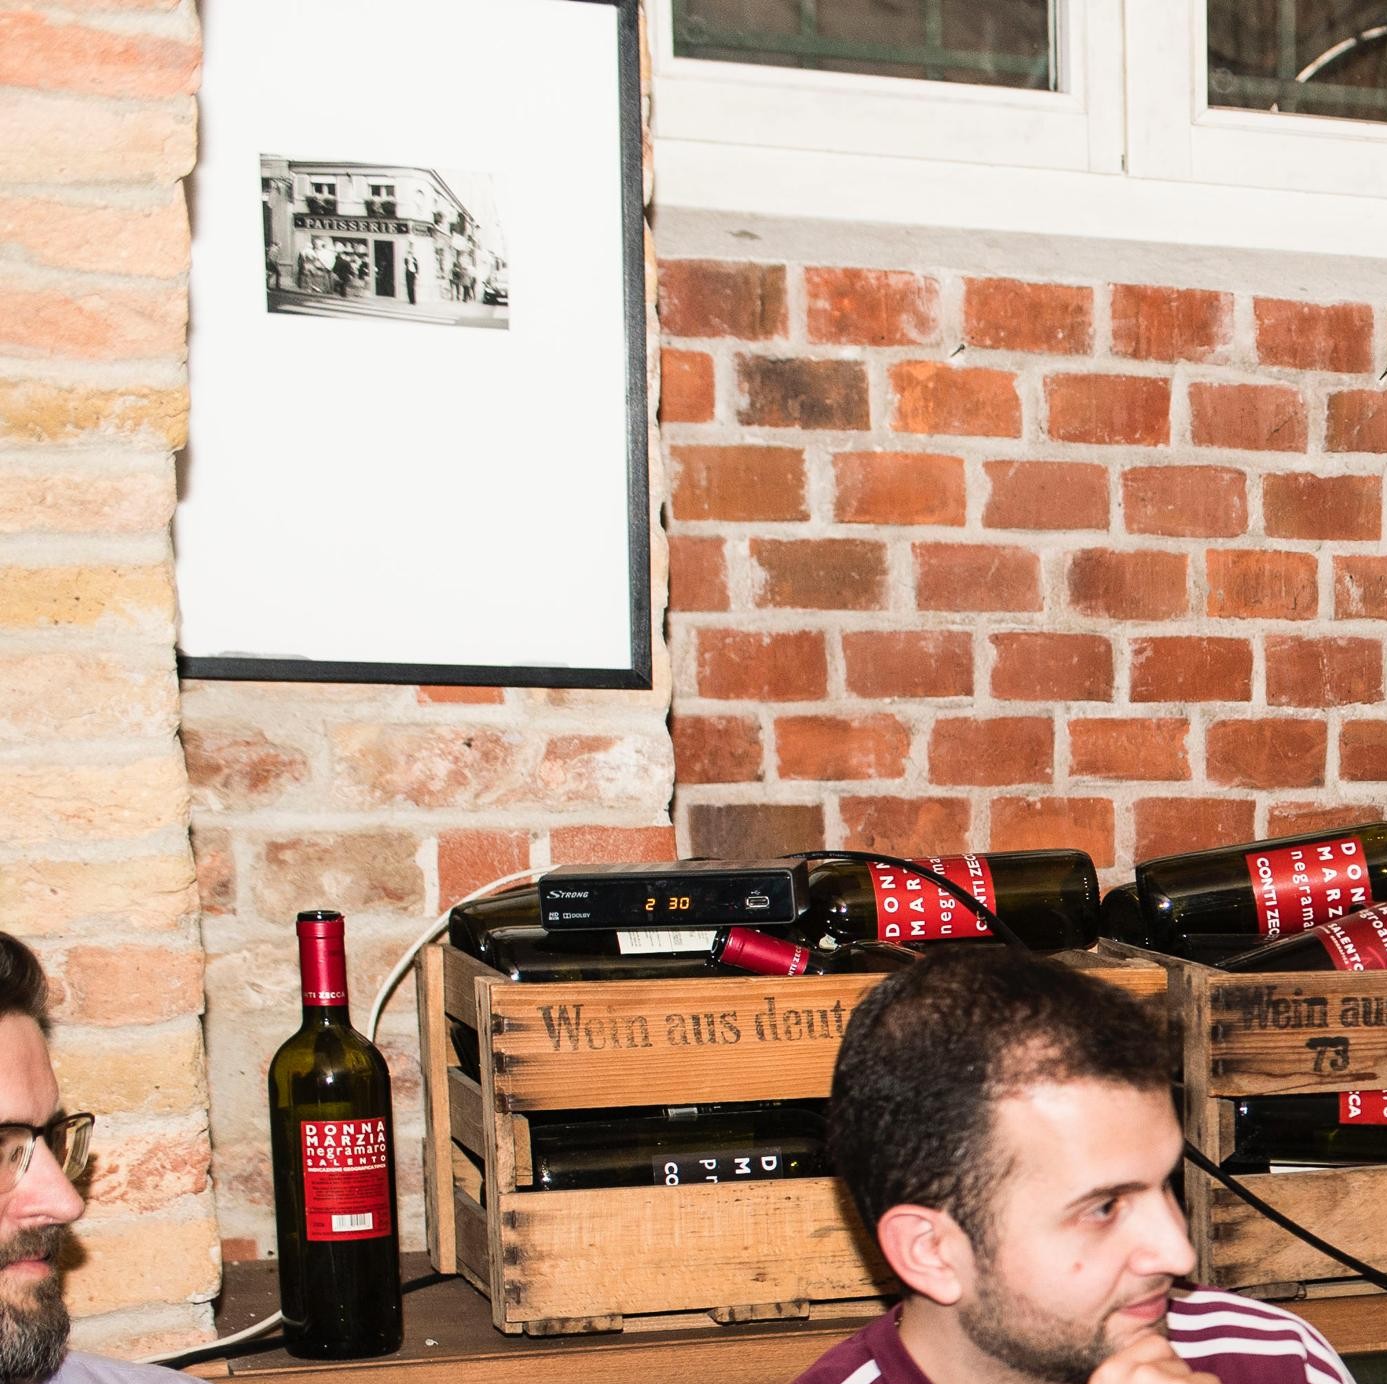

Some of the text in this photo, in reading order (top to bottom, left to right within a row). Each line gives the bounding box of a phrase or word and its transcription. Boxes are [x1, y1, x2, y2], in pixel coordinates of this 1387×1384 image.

[304, 220, 399, 233] PATISSERIE
[1256, 857, 1277, 906] CONTI
[546, 890, 589, 900] STRONG
[903, 859, 926, 936] MAR
[669, 897, 690, 910] 30
[571, 912, 591, 920] DOLBY
[1240, 984, 1329, 1031] Wein
[537, 1003, 653, 1051] Wein
[665, 1009, 742, 1046] aus
[1305, 1036, 1351, 1072] 73
[305, 1121, 385, 1136] DONNA
[306, 1132, 386, 1147] MARZIA
[306, 1143, 386, 1159] negramaro
[306, 1154, 386, 1167] SALENTO
